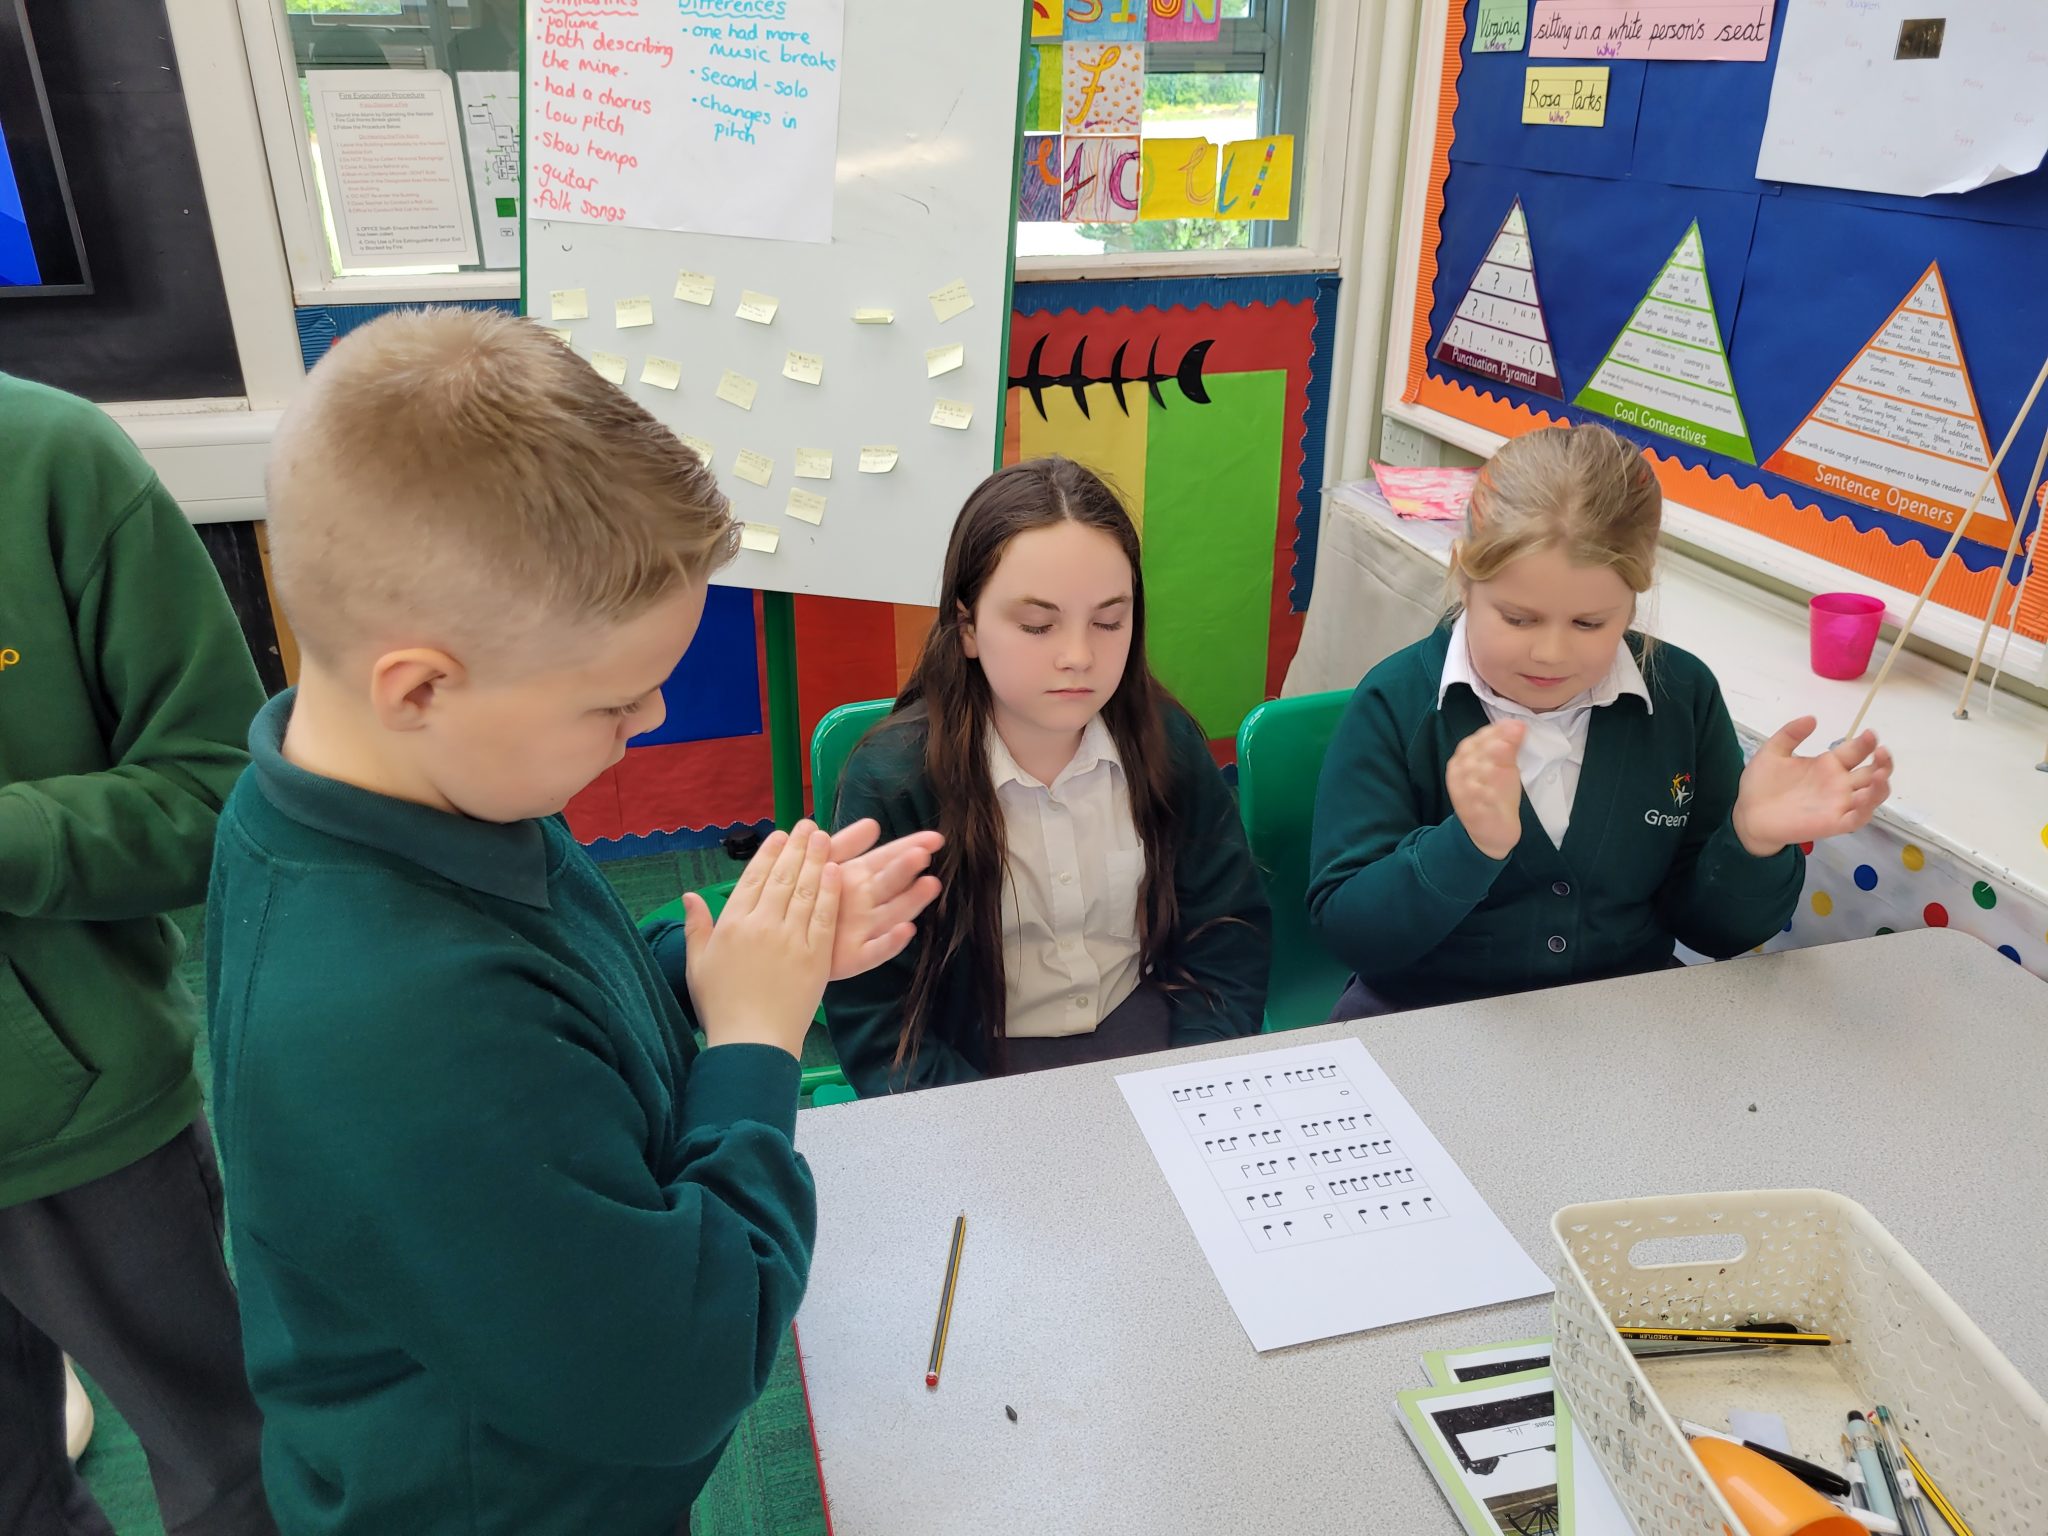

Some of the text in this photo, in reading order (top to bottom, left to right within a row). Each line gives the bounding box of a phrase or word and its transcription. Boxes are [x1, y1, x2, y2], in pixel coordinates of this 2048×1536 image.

[692, 23, 811, 45] one had more
[1480, 8, 1520, 46] Virginia
[1534, 6, 1766, 51] sitting in a white person's seat
[543, 50, 569, 71] the
[546, 26, 674, 69] both describing
[780, 43, 837, 72] breaks
[545, 76, 651, 114] had a chorus
[700, 94, 798, 129] changes in
[1529, 79, 1602, 112] Rosa Parks
[582, 111, 625, 136] pitch
[714, 119, 756, 145] pitch
[587, 140, 638, 174] tempo
[539, 163, 599, 192] guitar
[540, 189, 626, 222] folk songs
[1451, 347, 1538, 387] Punctuation Pyramid
[1614, 401, 1708, 446] Cool Connectives
[1860, 458, 1883, 470] sentence
[1884, 465, 1906, 478] openers
[1915, 473, 1930, 486] keep
[1930, 479, 1941, 488] the
[1942, 483, 1963, 494] reader
[1814, 464, 1955, 525] Sentence Openers
[1644, 809, 1690, 827] Green
